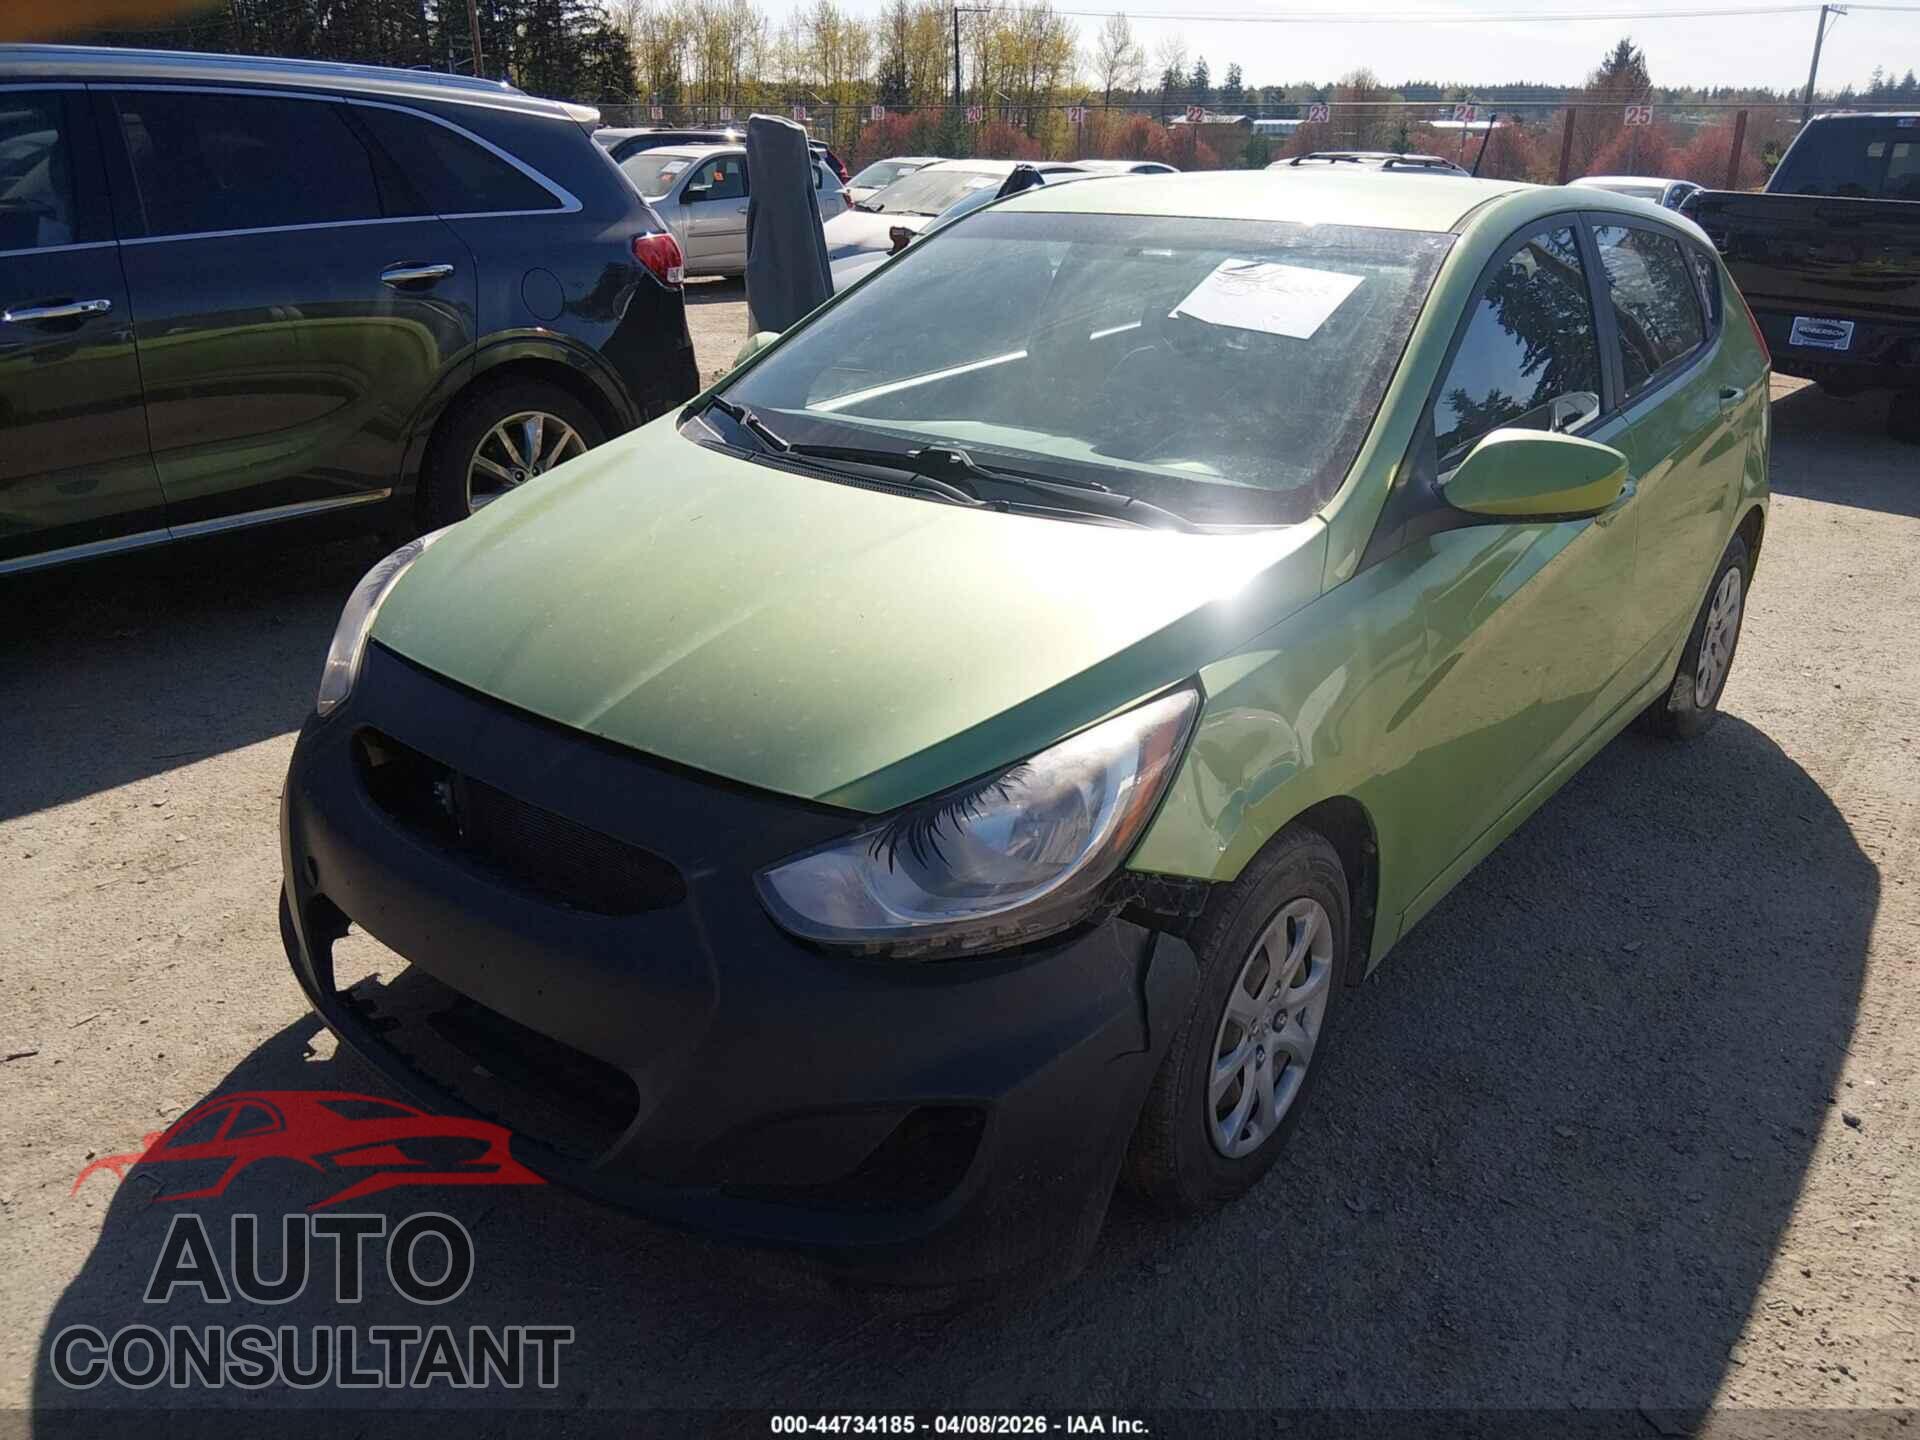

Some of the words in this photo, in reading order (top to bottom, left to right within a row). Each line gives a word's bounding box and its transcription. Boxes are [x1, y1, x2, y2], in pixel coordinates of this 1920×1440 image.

[873, 107, 883, 119] 19
[968, 107, 981, 121] 20
[1071, 108, 1082, 121] 21
[1188, 107, 1204, 121] 22
[1311, 106, 1328, 121] 23
[1456, 106, 1474, 121] 24
[1627, 107, 1649, 123] 25
